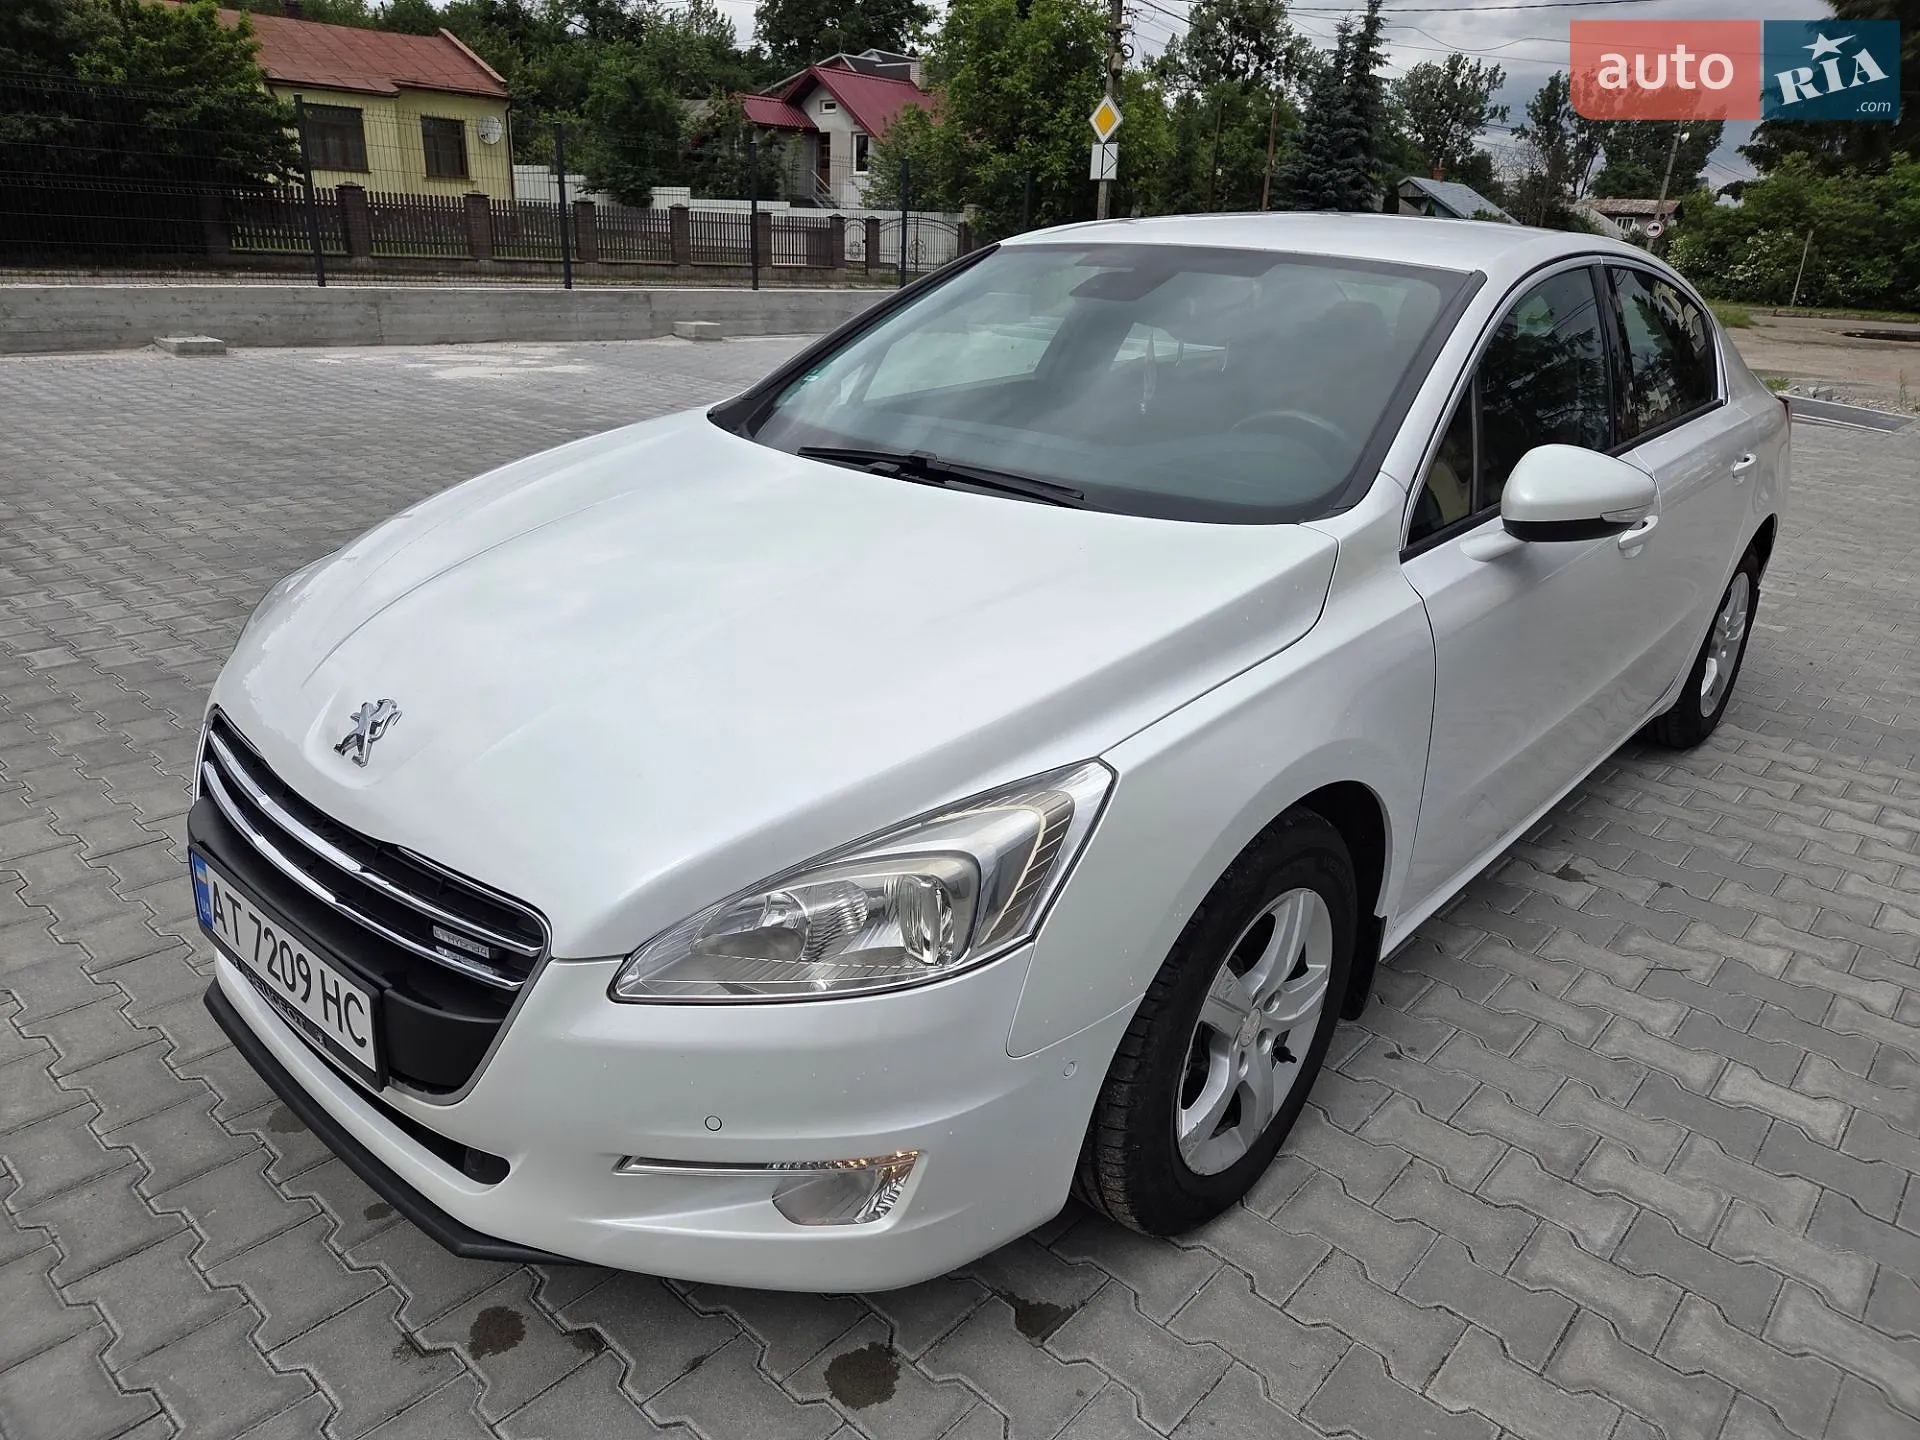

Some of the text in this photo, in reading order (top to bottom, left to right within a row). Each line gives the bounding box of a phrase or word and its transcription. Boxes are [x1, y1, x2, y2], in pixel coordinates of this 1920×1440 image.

[213, 880, 367, 1048] AT 7209 HC
